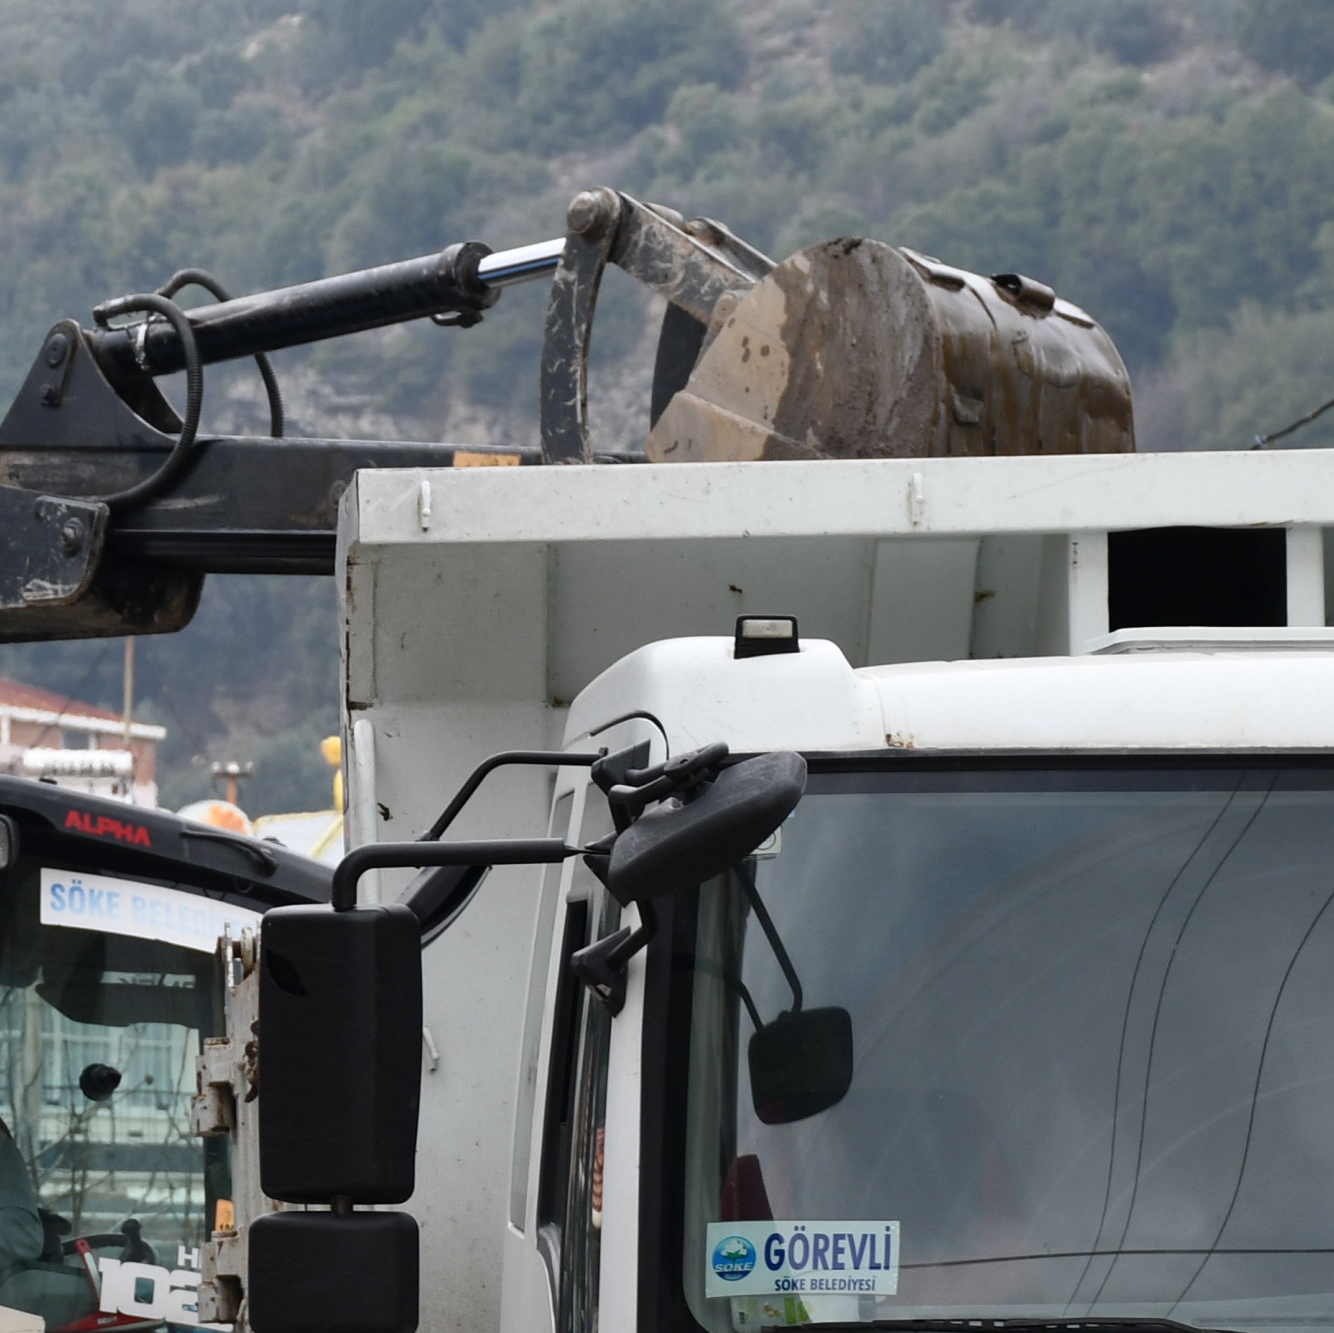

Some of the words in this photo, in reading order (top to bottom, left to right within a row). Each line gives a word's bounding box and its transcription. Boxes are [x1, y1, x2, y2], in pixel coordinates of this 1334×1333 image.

[65, 810, 152, 847] ALPHA
[49, 878, 121, 919] SÖKE
[763, 1225, 892, 1272] GÖREVLİ
[774, 1275, 806, 1292] SÖKE
[809, 1275, 876, 1292] BELEDİYESİ
